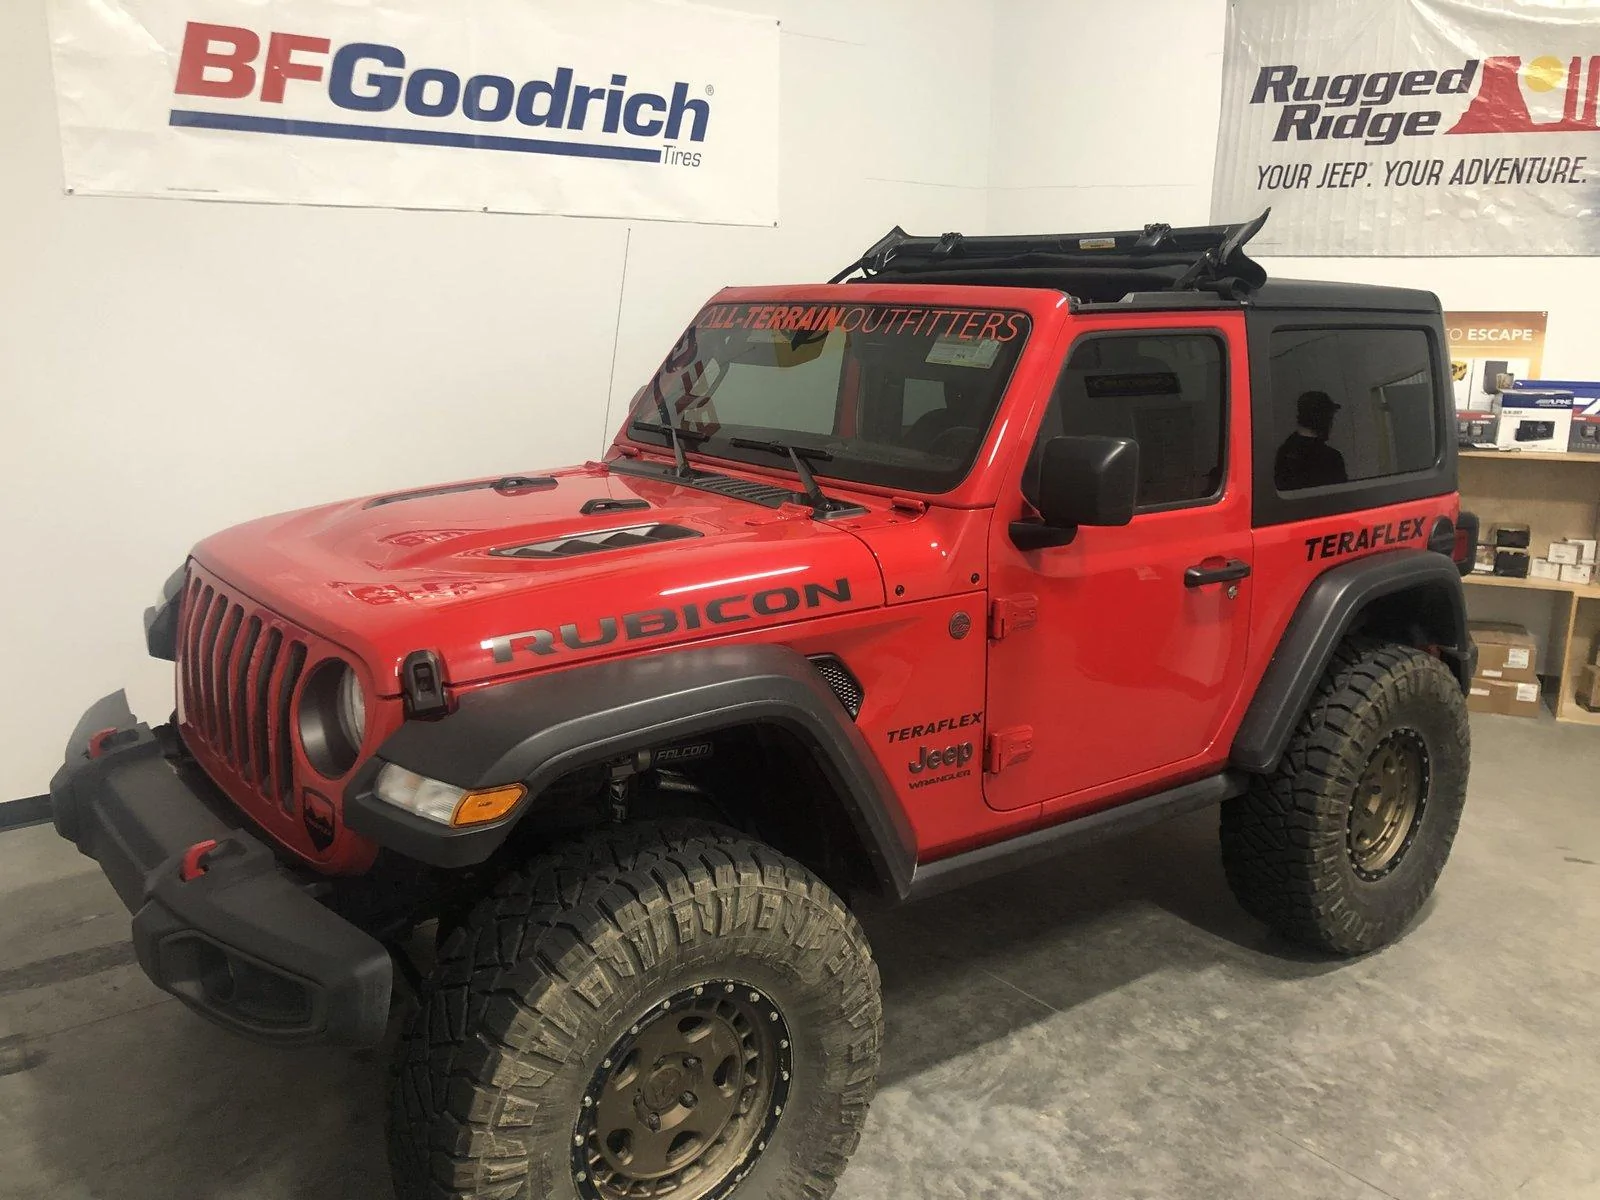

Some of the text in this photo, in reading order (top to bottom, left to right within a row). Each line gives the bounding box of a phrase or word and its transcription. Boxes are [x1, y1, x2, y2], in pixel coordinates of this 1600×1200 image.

[175, 22, 709, 142] BFGoodrich
[1250, 59, 1479, 108] Rugged
[1272, 104, 1442, 146] Ridge
[663, 144, 702, 167] Tires
[1257, 163, 1312, 190] YOUR
[1383, 159, 1444, 187] YOUR
[1448, 156, 1588, 185] ADVENTURE.
[840, 307, 1026, 342] OUTFITTERS
[1467, 328, 1533, 341] ESCAPE
[1305, 516, 1426, 562] TERAFLEX
[491, 578, 852, 664] RUBICON
[887, 711, 983, 743] TERAFLEX
[656, 744, 709, 761] FALCON
[908, 741, 973, 774] Jeep
[908, 769, 971, 790] WRANGLER
